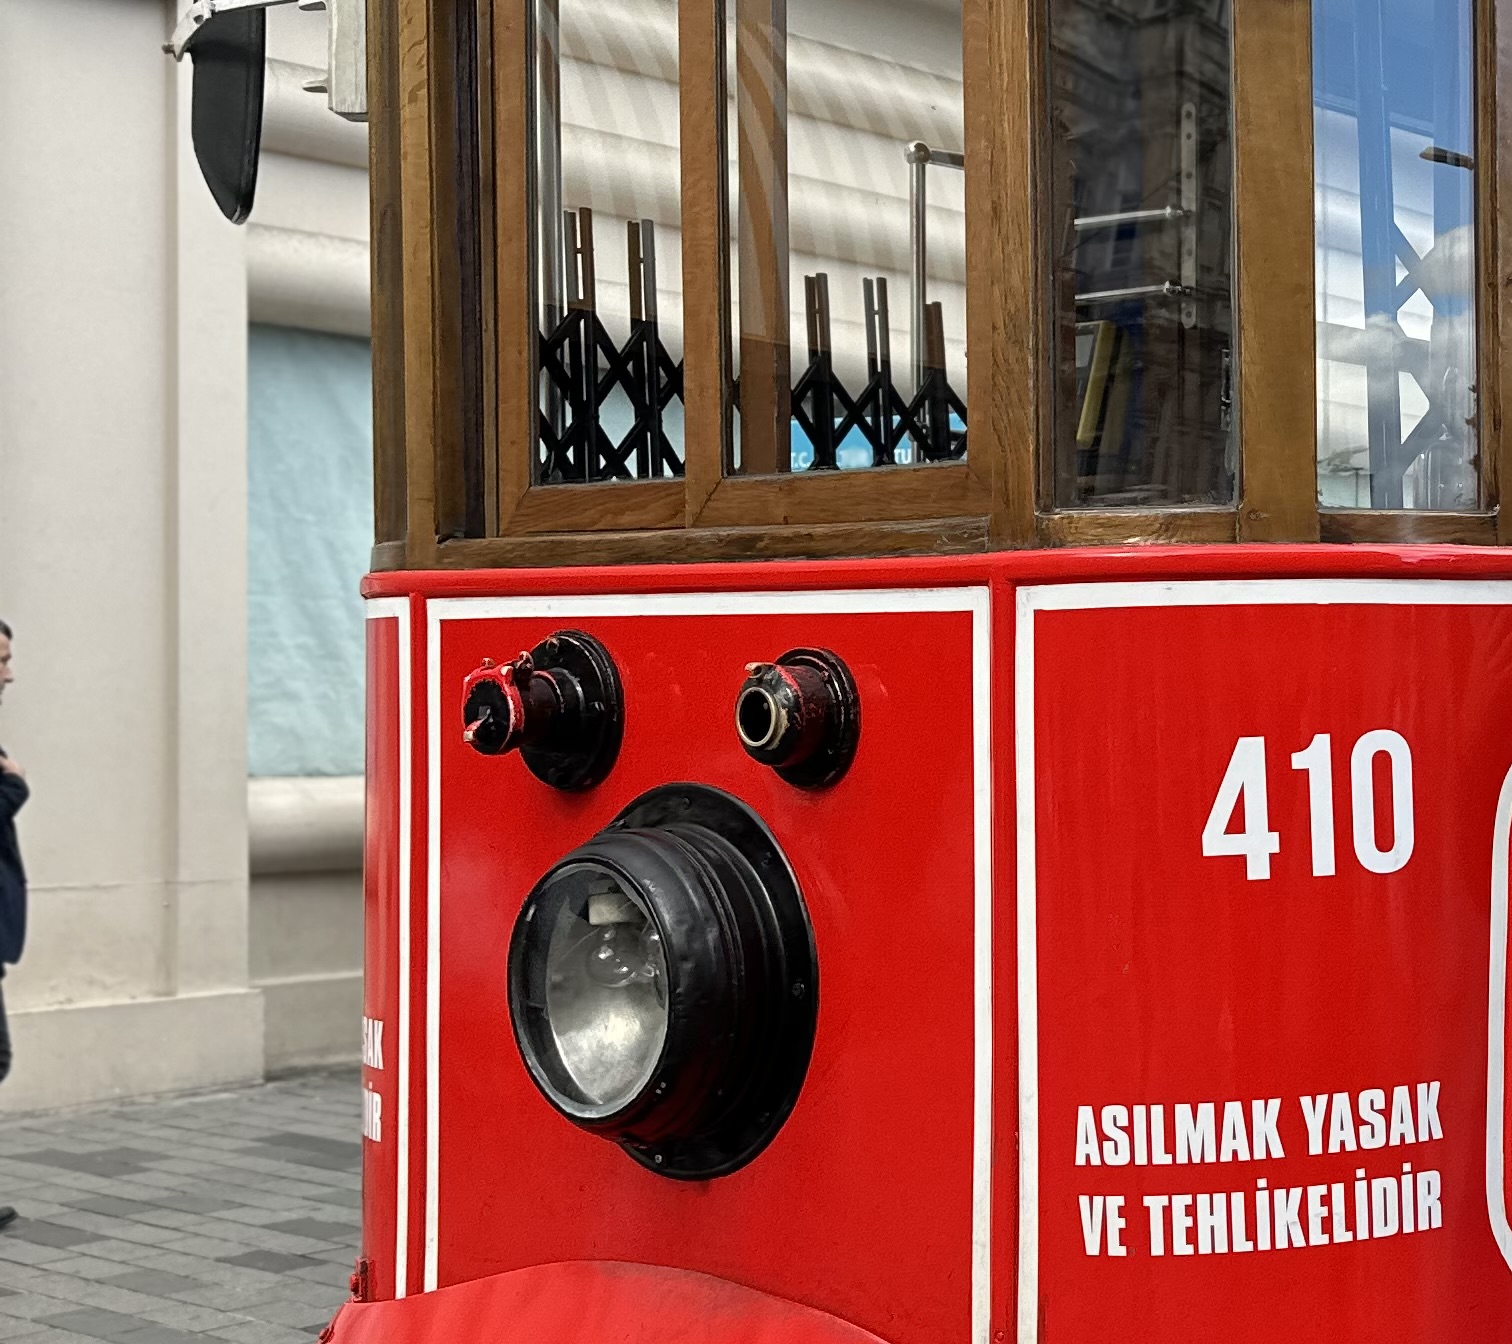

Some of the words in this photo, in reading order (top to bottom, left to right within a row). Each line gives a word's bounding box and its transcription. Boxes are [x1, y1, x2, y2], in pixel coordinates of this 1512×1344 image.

[1201, 728, 1415, 881] 410
[1075, 1097, 1286, 1166] ASILMAK
[1299, 1080, 1444, 1156] YASAK
[1078, 1194, 1128, 1257] VE
[1142, 1161, 1443, 1256] TEHLİKELİDİR
